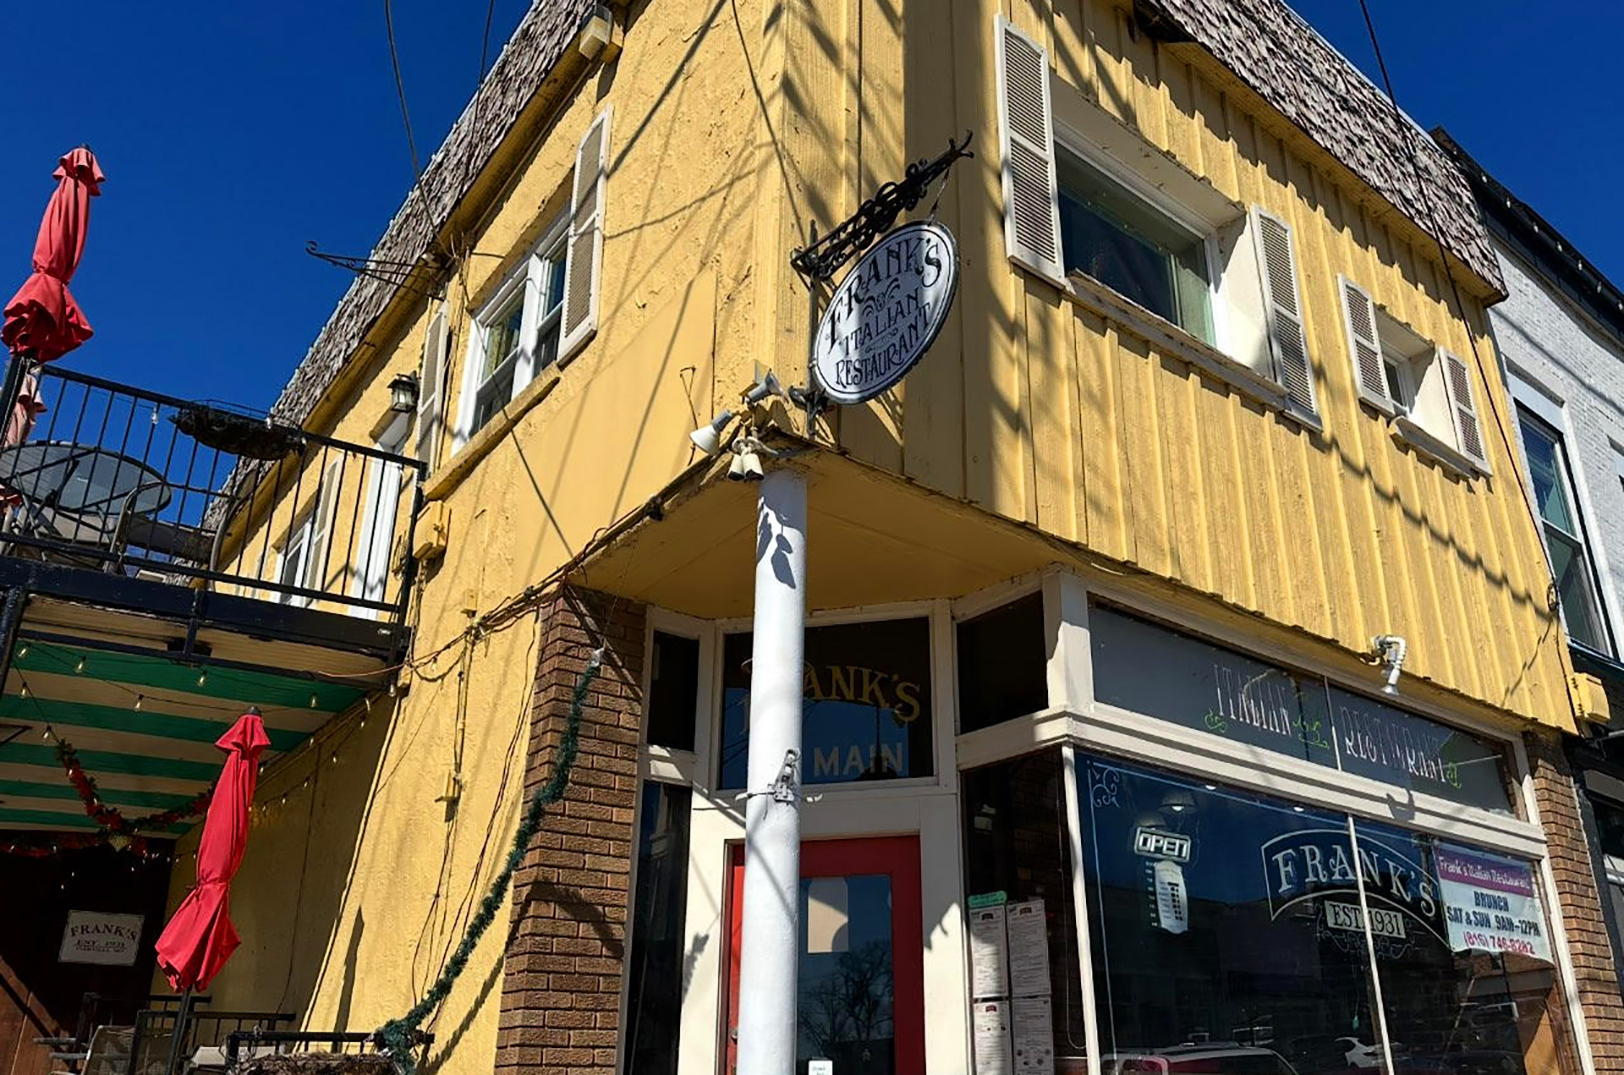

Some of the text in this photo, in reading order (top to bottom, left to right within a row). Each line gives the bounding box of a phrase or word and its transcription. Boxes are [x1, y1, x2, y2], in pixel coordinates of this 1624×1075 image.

[827, 237, 943, 355] FRANK'S
[844, 287, 920, 356] ITALIAN
[835, 302, 931, 389] RESTAURANT
[1213, 664, 1292, 737] ITALIAN
[813, 743, 904, 778] MAIN
[1138, 832, 1188, 858] OPEN
[1272, 844, 1436, 918] FRANK'S
[1474, 891, 1510, 912] BRUNCH
[70, 923, 138, 940] FRANK'S
[1368, 909, 1402, 936] 1931
[1446, 906, 1463, 924] SAT
[1464, 911, 1473, 926] &
[1472, 910, 1492, 929] SUN
[1463, 931, 1490, 949] (816)
